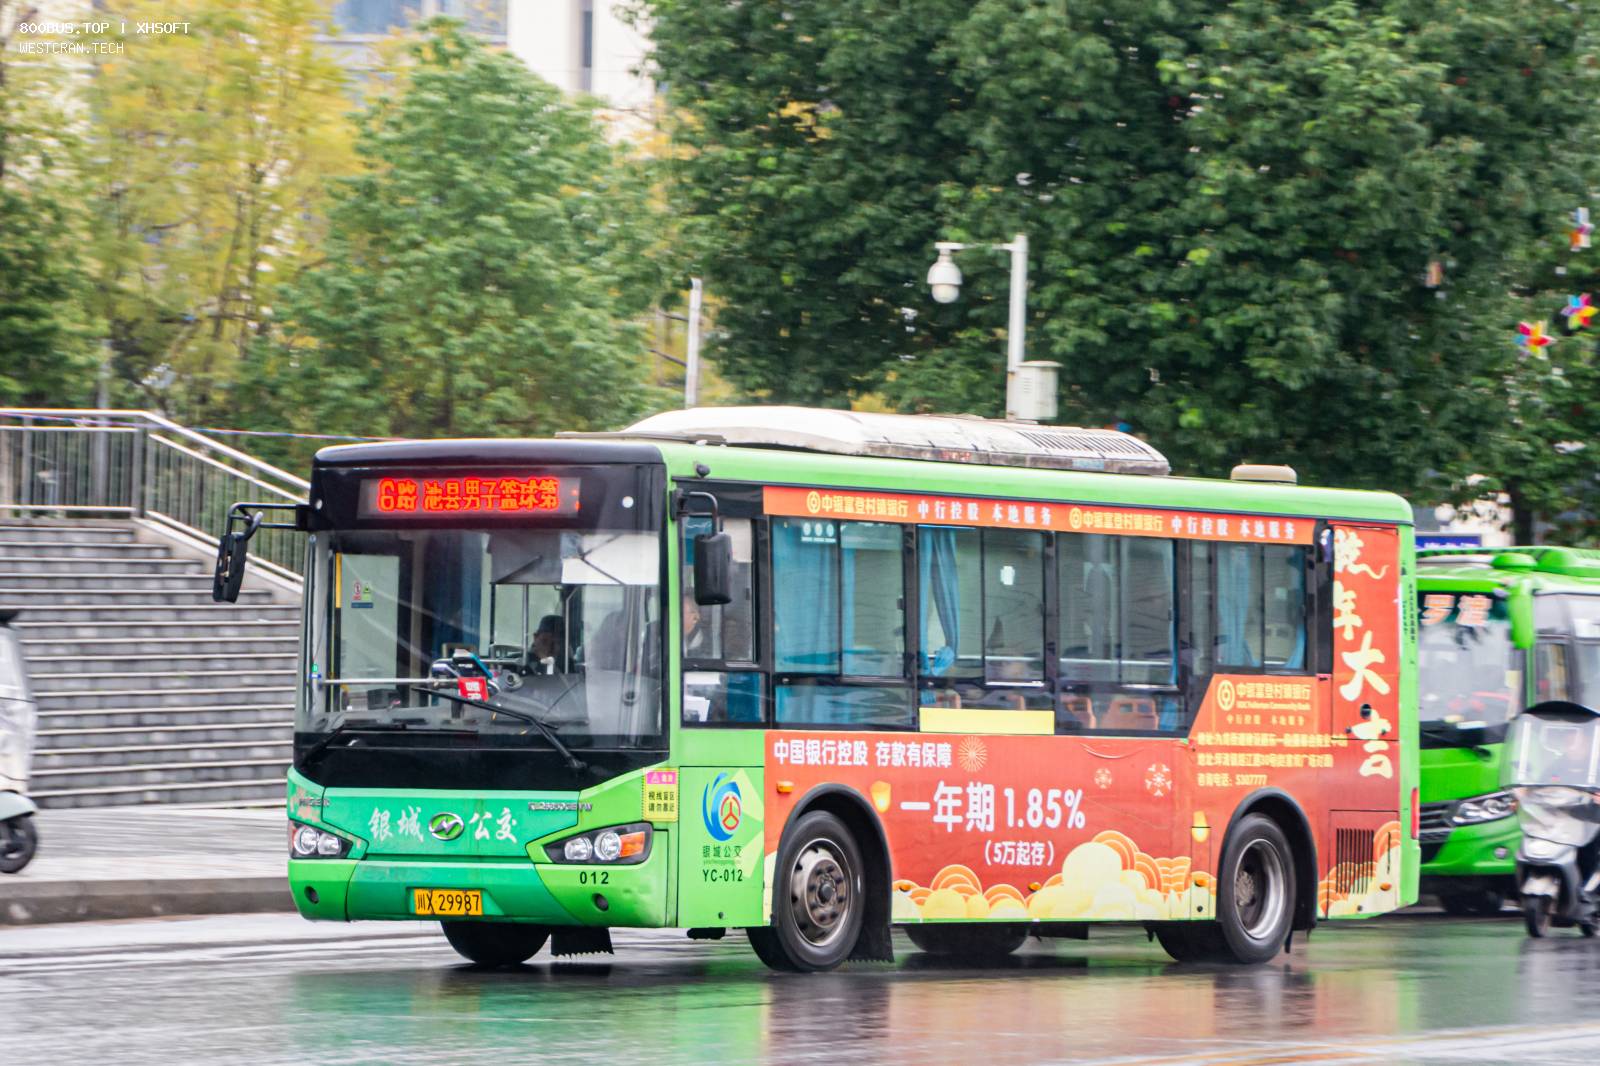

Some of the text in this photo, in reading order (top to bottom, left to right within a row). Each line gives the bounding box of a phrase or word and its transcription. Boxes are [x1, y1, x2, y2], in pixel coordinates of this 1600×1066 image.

[918, 500, 979, 521] 中行控股
[992, 504, 1051, 526] 本地服务
[1171, 515, 1229, 537] 中行控股
[1239, 519, 1296, 540] 本地服务
[773, 739, 952, 768] 中国银行控股 存款有保障
[900, 781, 1085, 832] 一年期 1.85%
[368, 805, 518, 843] 银城 公交
[703, 845, 742, 858] 银城公交
[984, 840, 1055, 866] (5万起存)
[580, 871, 609, 885] 012
[703, 869, 743, 882] YC-012
